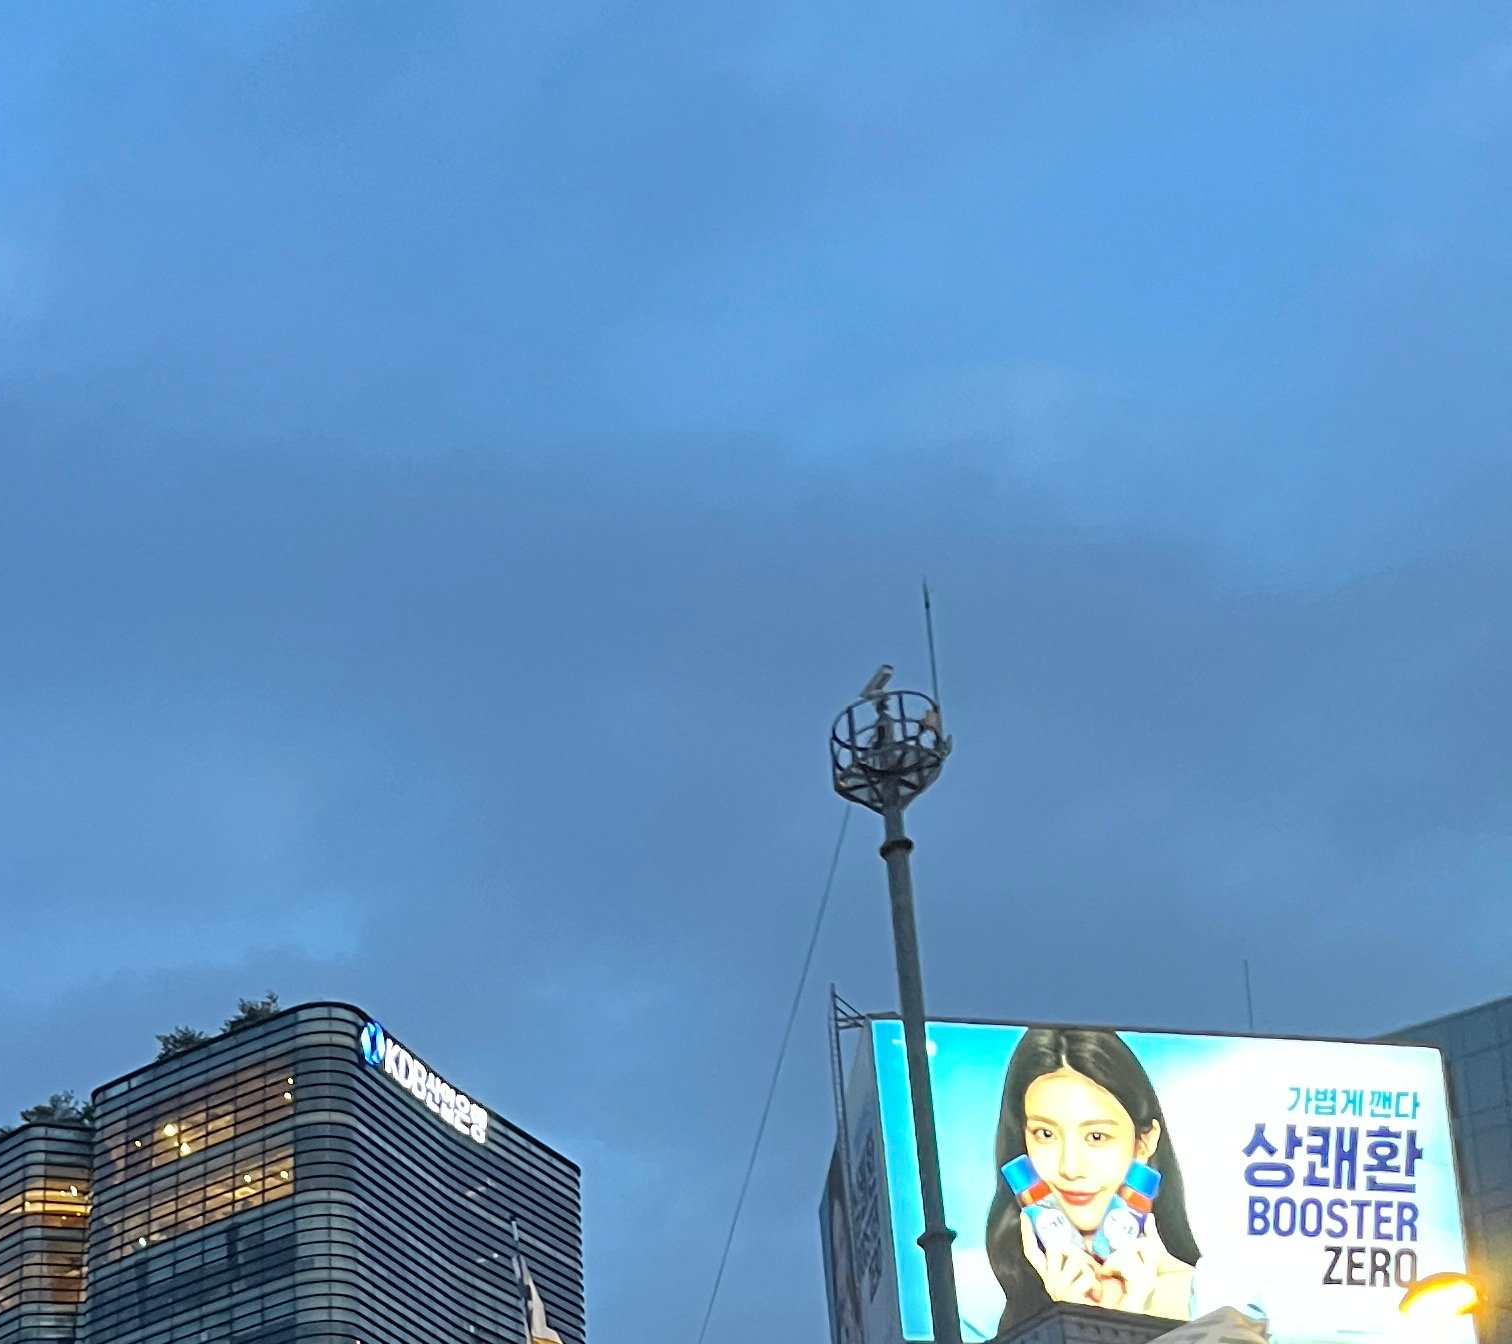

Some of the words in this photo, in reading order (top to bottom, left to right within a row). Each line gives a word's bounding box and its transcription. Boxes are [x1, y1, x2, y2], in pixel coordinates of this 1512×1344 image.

[1287, 1087, 1364, 1118] 가볍게
[1368, 1090, 1420, 1119] 깬다
[1242, 1123, 1424, 1193] 상쾌환
[1247, 1196, 1419, 1242] BOOSTER
[1322, 1245, 1417, 1289] ZERO
